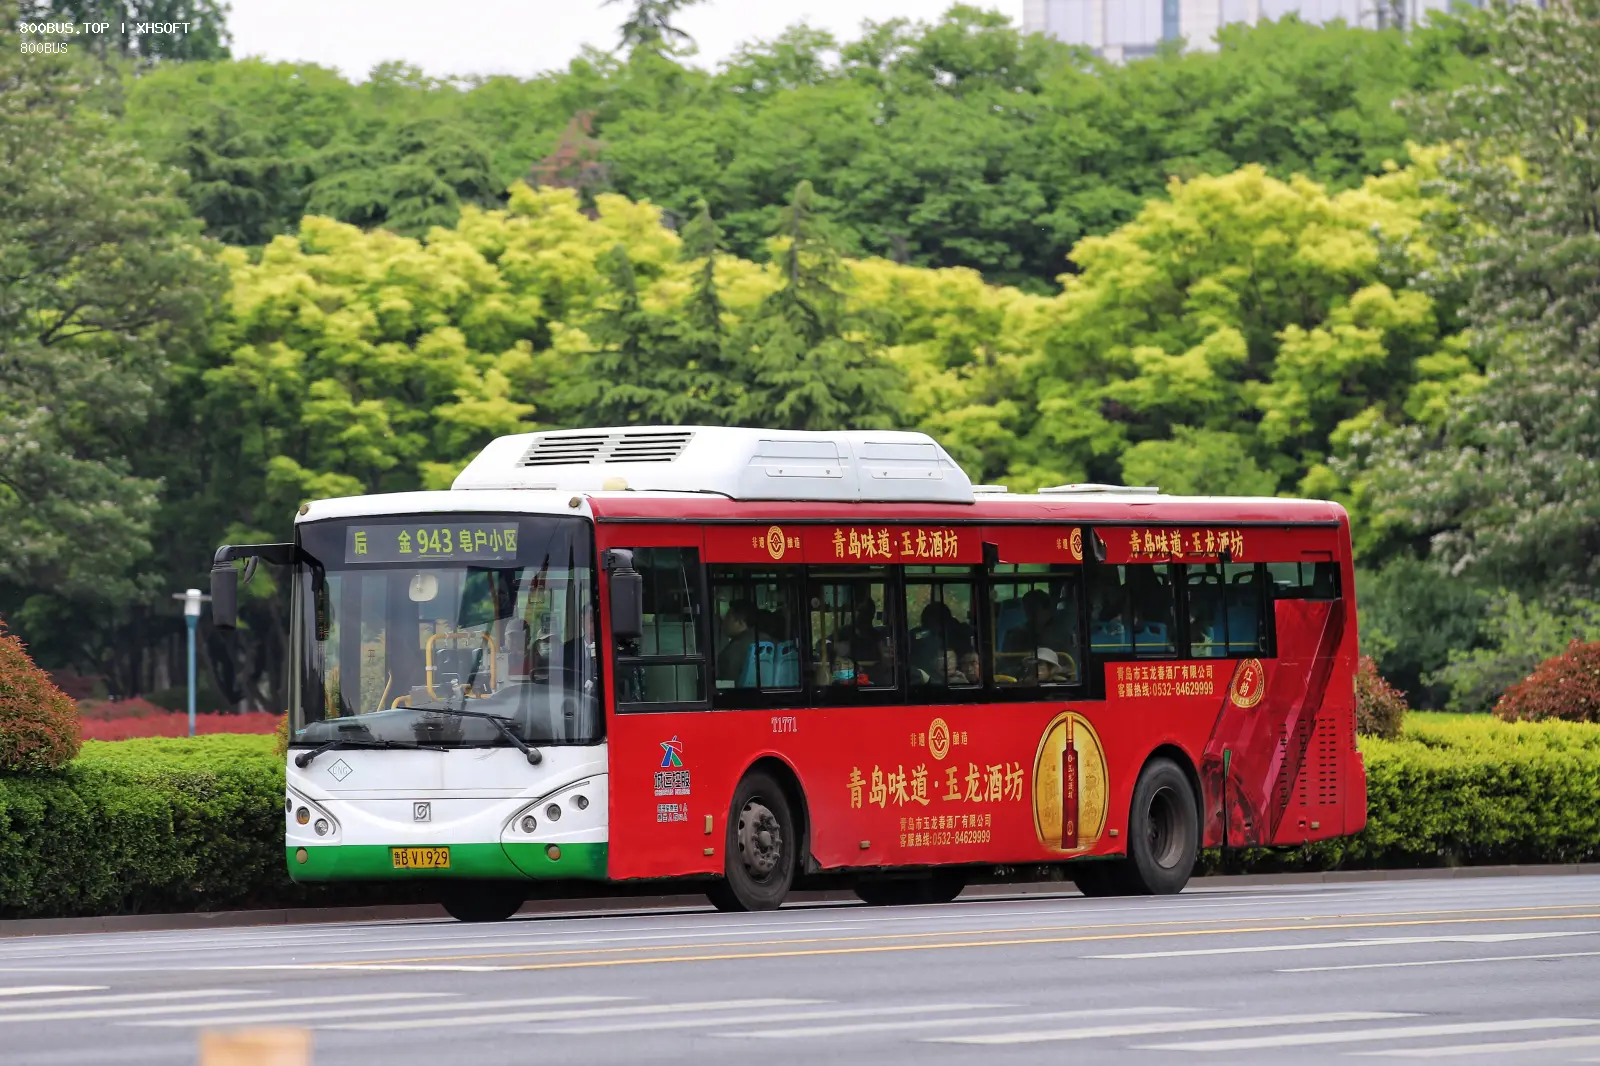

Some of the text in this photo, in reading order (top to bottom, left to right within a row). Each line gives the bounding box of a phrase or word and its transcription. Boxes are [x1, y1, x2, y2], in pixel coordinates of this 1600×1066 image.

[354, 528, 517, 555] 后 金 943 皂户小区
[832, 527, 958, 559] 青岛味道·玉龙酒坊
[1117, 664, 1214, 681] 青岛市玉龙春酒厂有限公司
[846, 761, 1025, 809] 青岛味道·玉龙酒坊
[900, 813, 992, 832] 青岛市玉龙春酒厂有限公司
